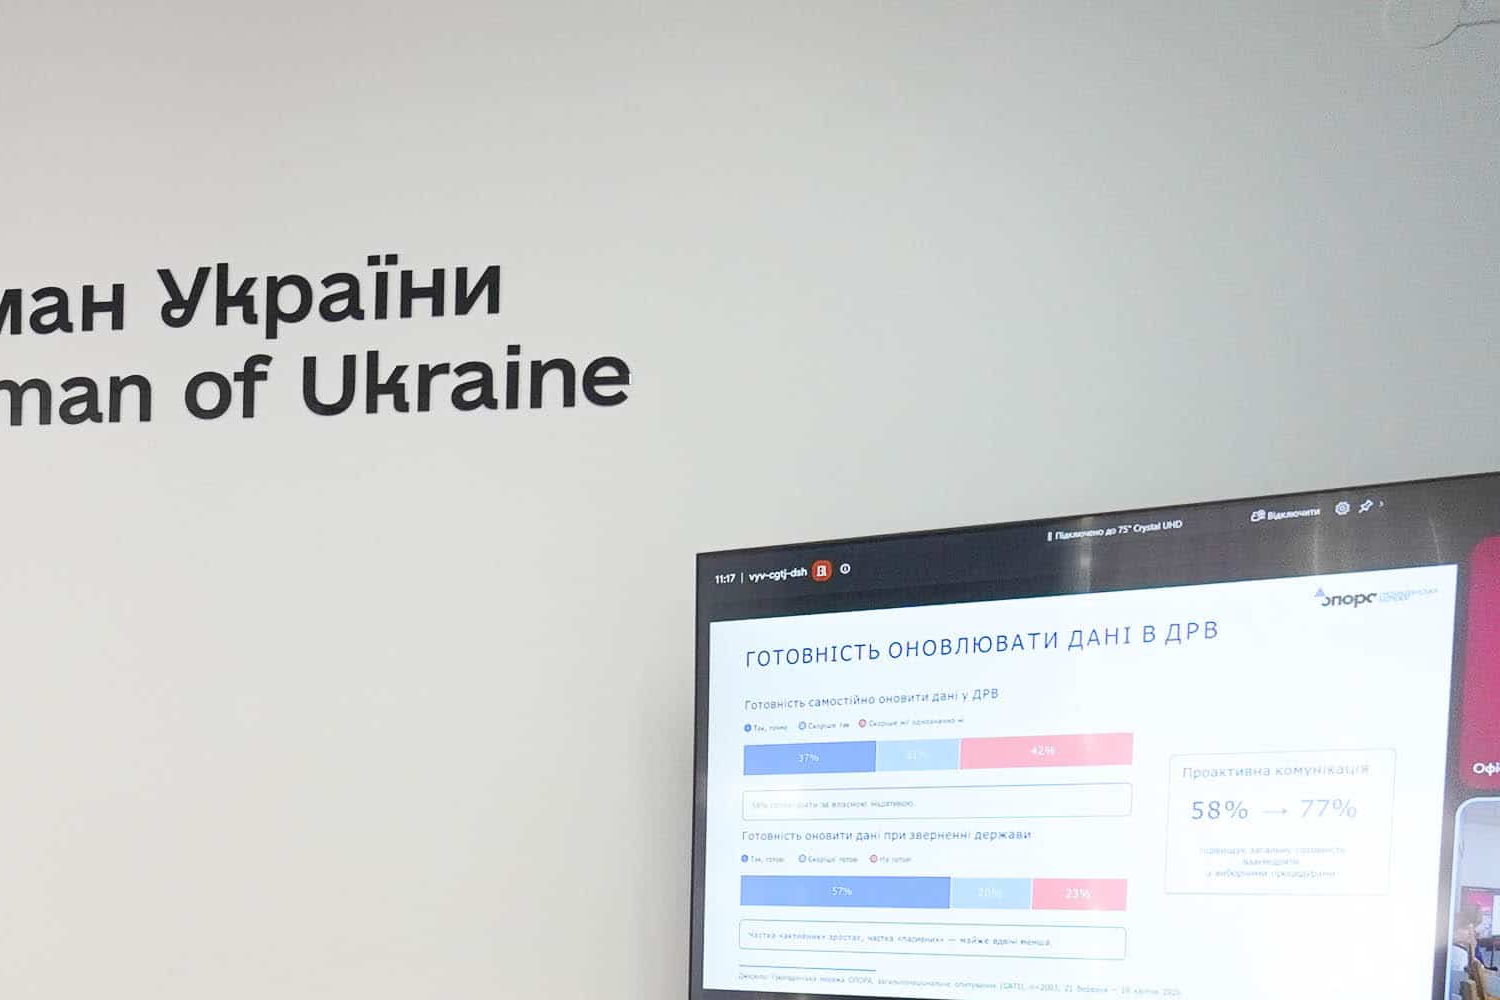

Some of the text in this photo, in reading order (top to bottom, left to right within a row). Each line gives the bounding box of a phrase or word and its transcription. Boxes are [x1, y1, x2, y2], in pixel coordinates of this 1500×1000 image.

[155, 253, 501, 340] України
[185, 354, 274, 420] of
[303, 344, 632, 416] Ukraine
[1105, 527, 1117, 537] до
[1133, 521, 1161, 534] Crystal
[1162, 519, 1183, 530] UHD
[715, 573, 736, 585] 11:17
[745, 620, 1218, 668] ГОТОВНІСТЬ ОНОВЛЮВАТИ ДАНІ В ДРВ
[744, 699, 806, 711] Готовність
[808, 694, 876, 708] самостійно
[878, 693, 929, 704] оновити
[931, 691, 958, 703] дані
[971, 688, 999, 702] ДРВ
[1182, 764, 1370, 780] Проактивна комунікація
[1191, 798, 1357, 820] 58% 77%
[741, 831, 1032, 842] Готовність оновити дані при зверненні держави
